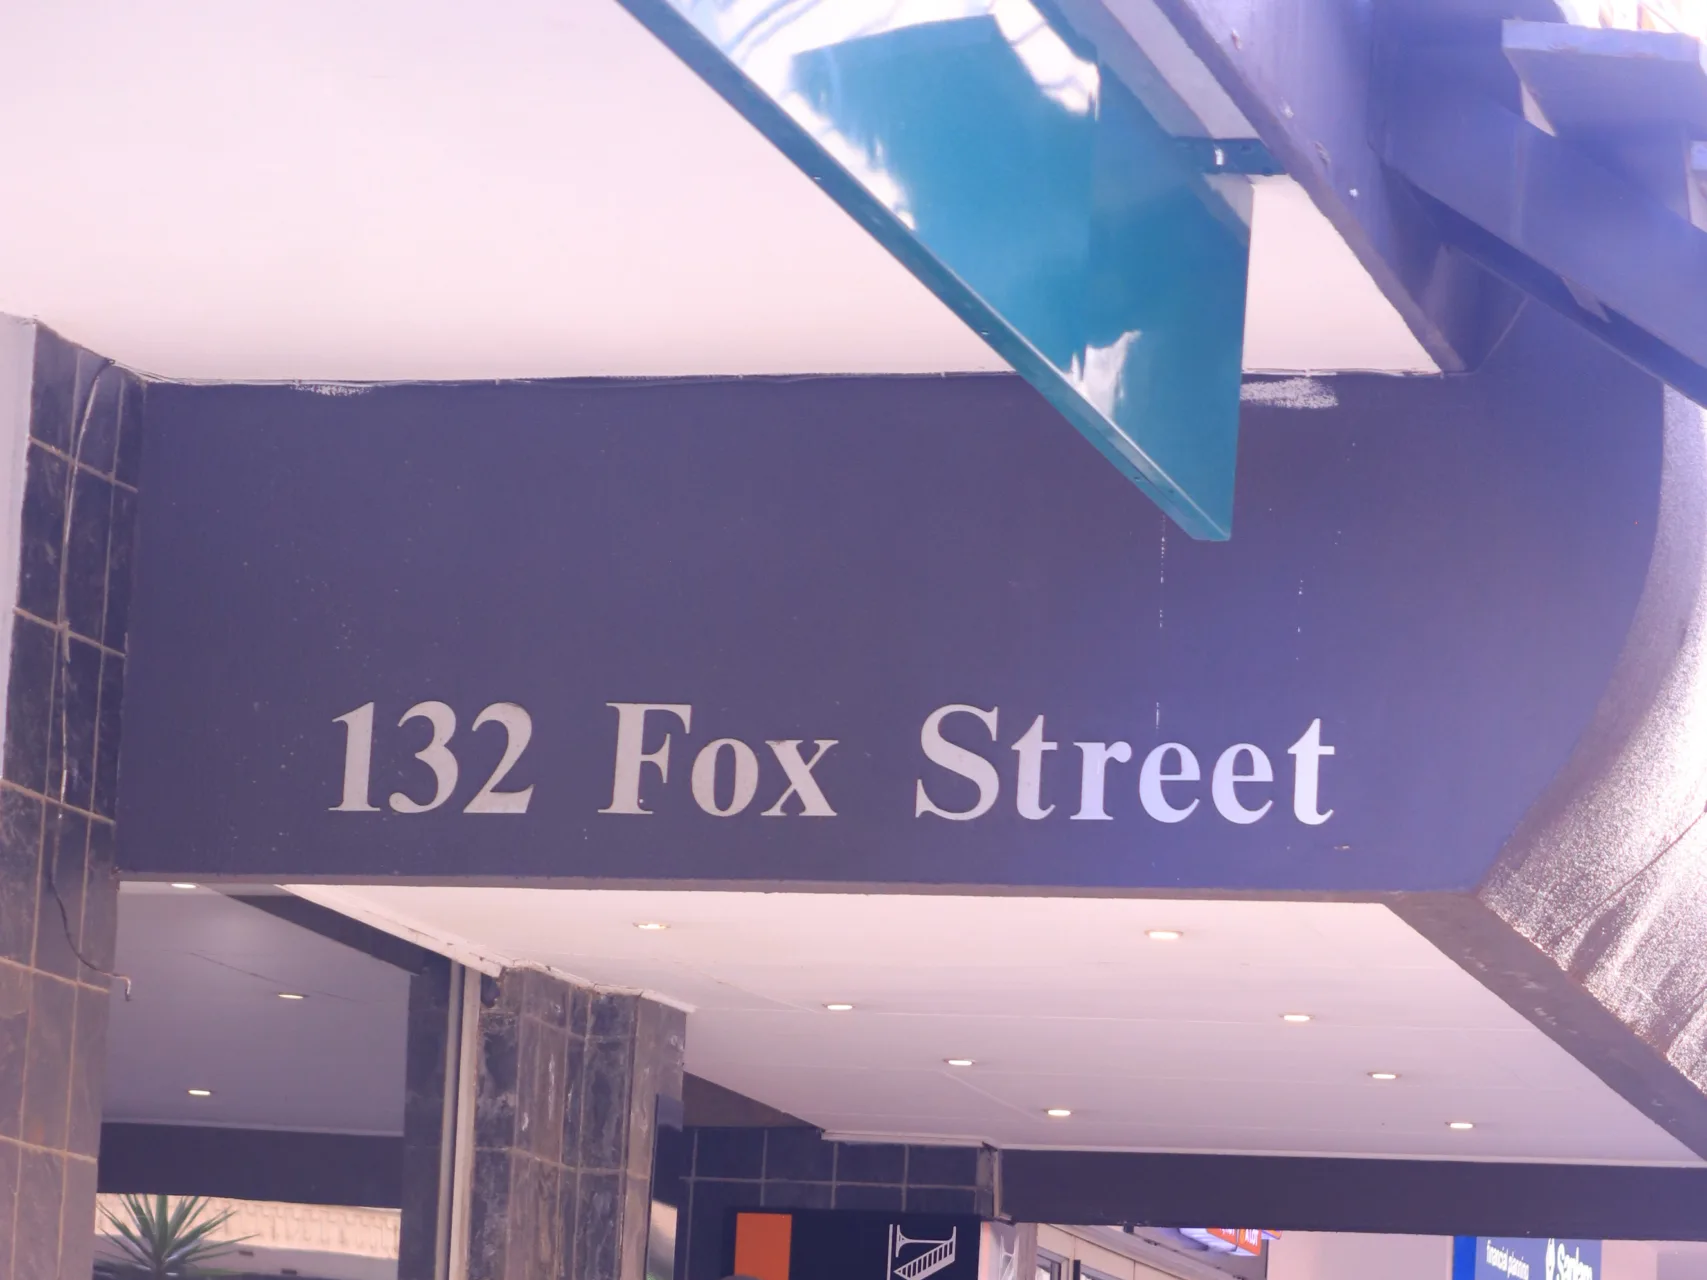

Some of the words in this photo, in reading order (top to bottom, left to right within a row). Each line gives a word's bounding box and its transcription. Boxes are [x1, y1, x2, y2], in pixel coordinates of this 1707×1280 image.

[329, 700, 535, 815] 132
[597, 702, 839, 817] Fox
[916, 704, 1335, 826] Street
[1486, 1239, 1509, 1273] financial
